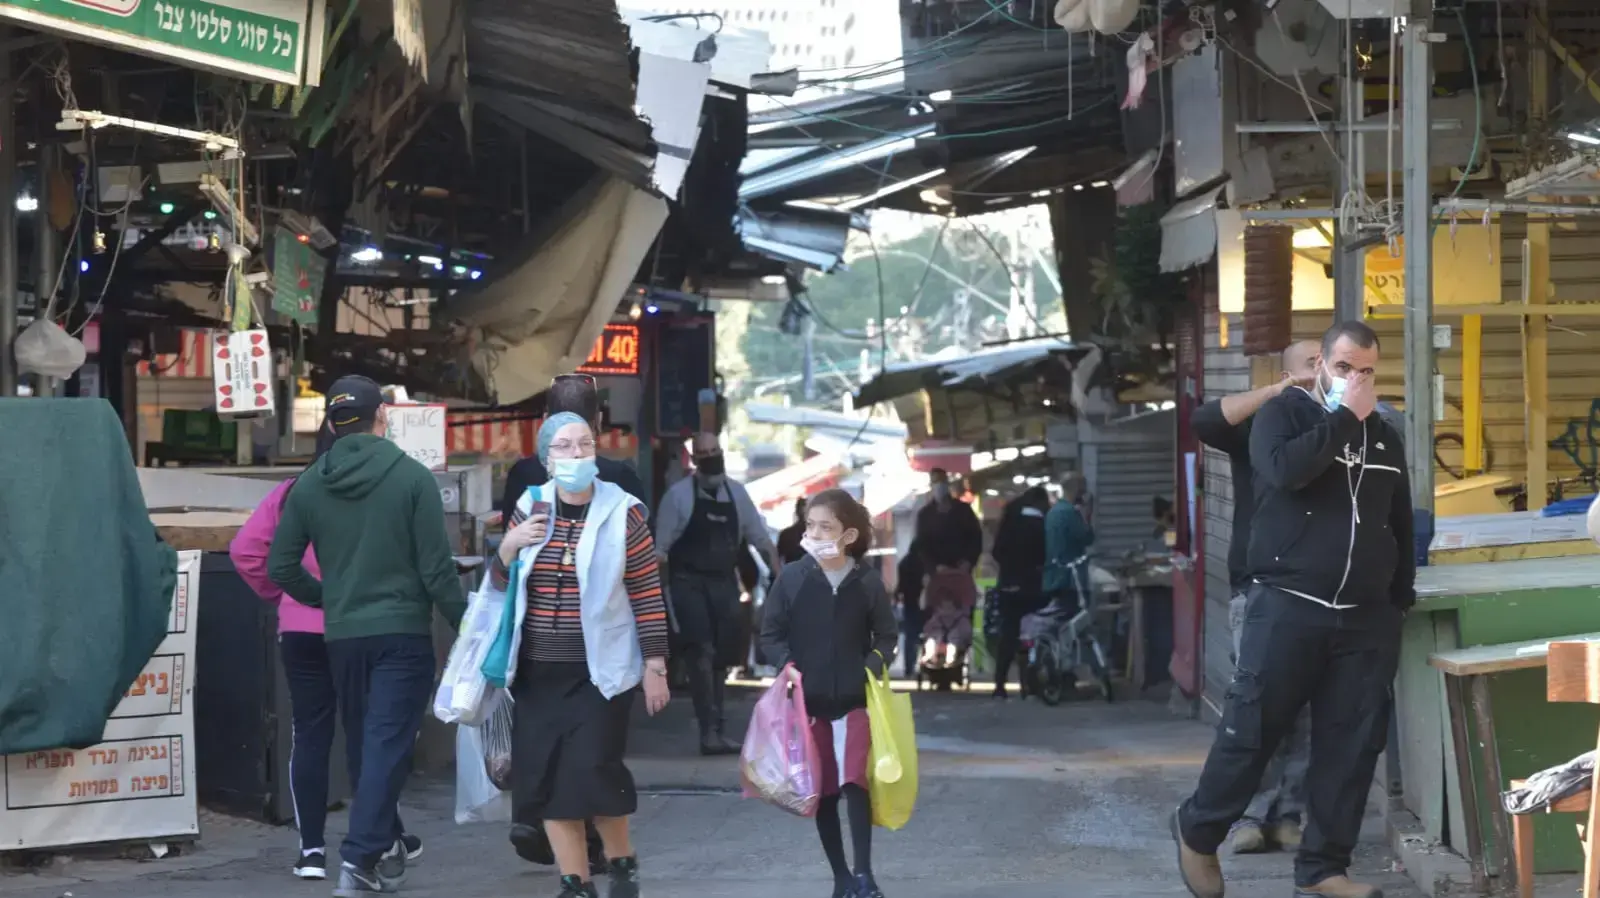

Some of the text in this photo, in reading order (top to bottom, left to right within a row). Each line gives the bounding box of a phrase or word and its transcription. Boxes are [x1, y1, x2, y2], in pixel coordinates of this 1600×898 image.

[153, 1, 293, 57] כל סוגי סלטי צבר
[607, 335, 634, 363] 40
[124, 672, 168, 697] ביצ
[88, 749, 118, 766] תרד
[127, 744, 168, 763] גבינה
[131, 774, 168, 793] פיצה
